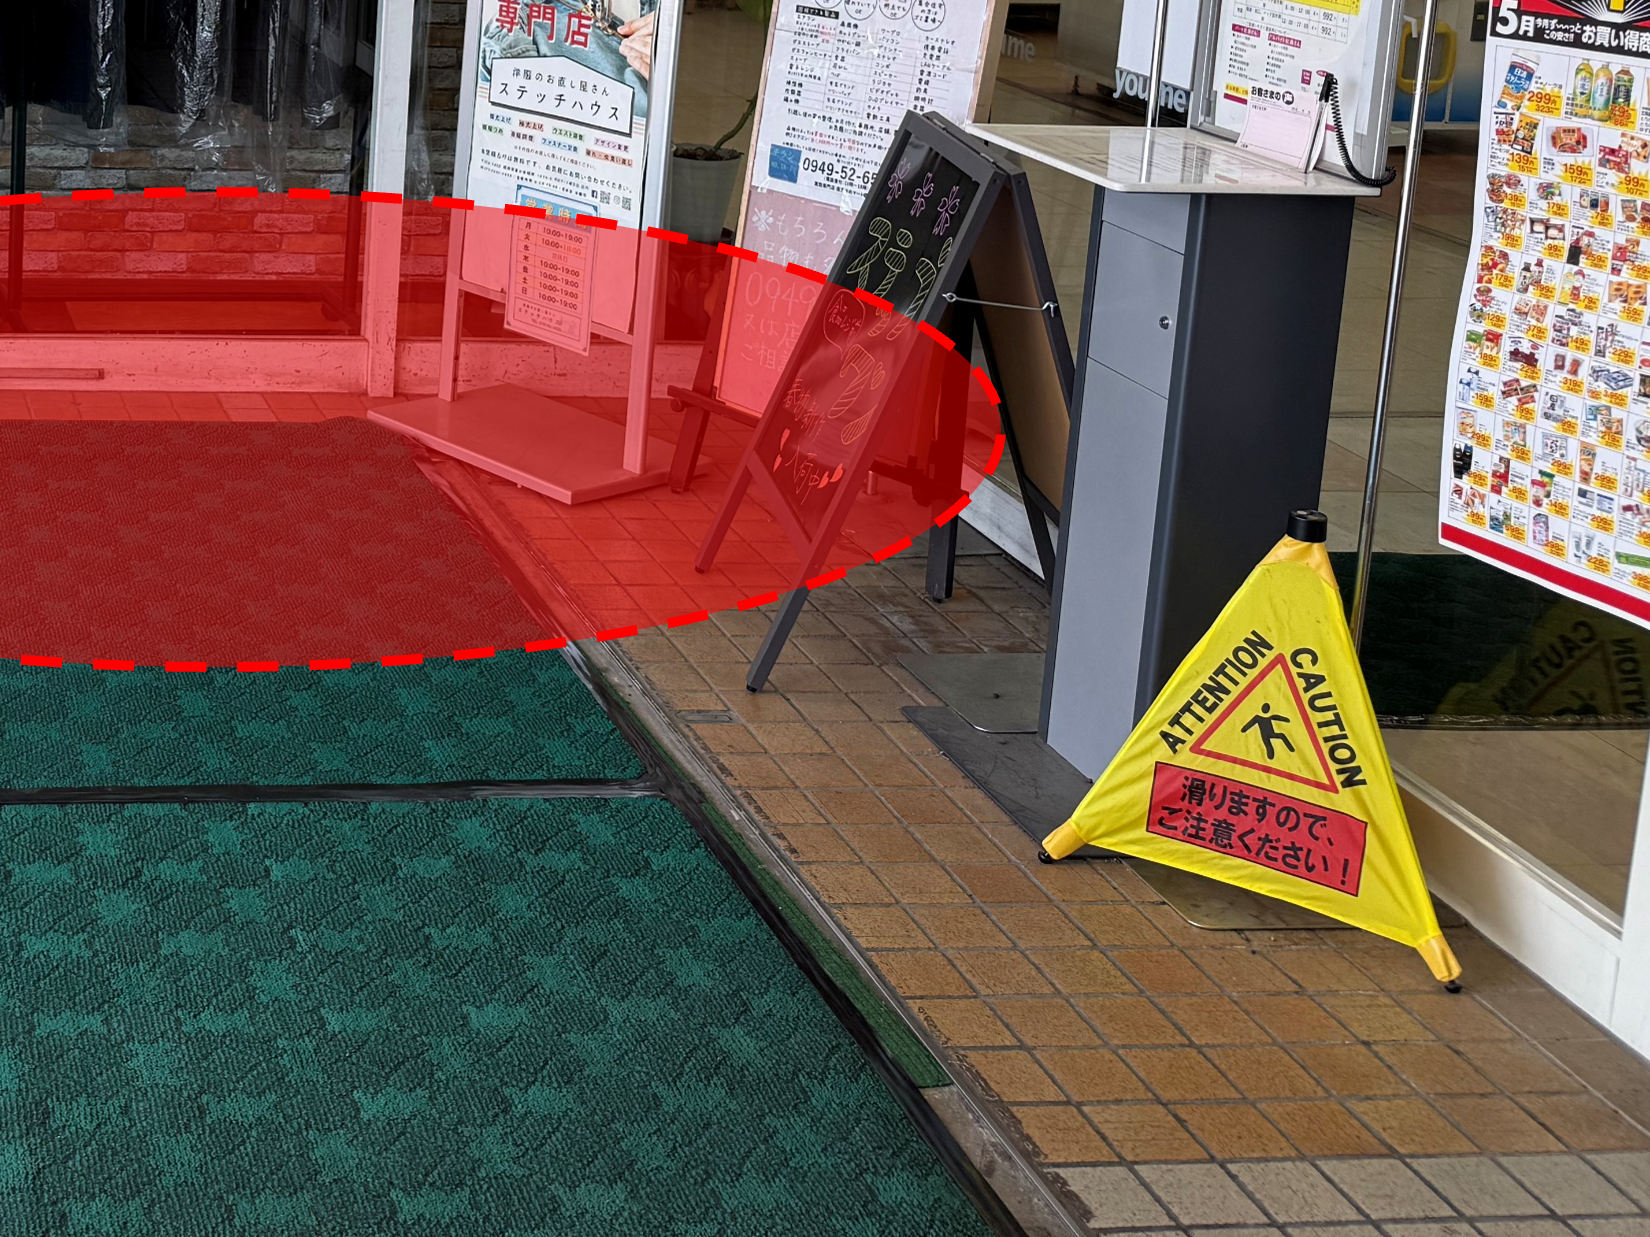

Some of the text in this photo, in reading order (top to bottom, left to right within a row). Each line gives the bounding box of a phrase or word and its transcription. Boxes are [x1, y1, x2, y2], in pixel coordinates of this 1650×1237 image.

[499, 82, 618, 121] ステッチハウス
[1158, 629, 1275, 756] ATTENTION
[1289, 646, 1367, 790] CAUTION
